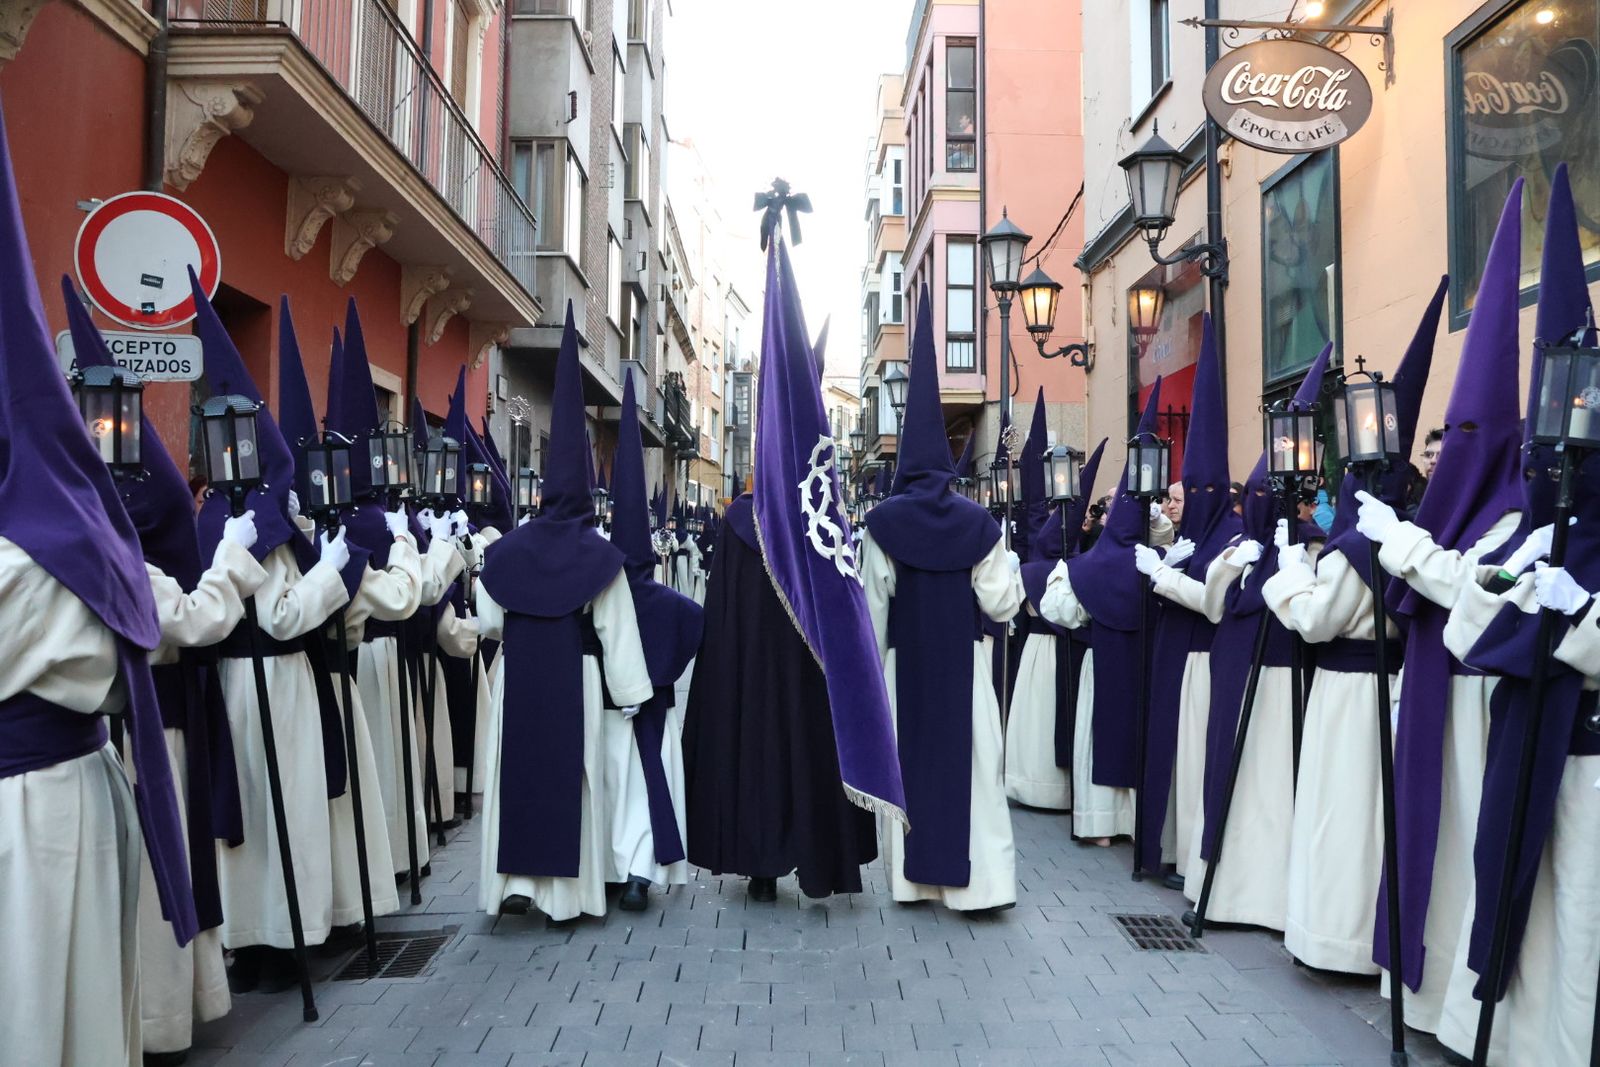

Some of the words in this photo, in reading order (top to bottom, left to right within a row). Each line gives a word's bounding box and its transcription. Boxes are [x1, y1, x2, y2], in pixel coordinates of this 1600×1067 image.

[1221, 61, 1352, 111] Coca-Cola
[1240, 117, 1291, 142] ÉPOCA
[1294, 121, 1335, 141] CAFÉ
[105, 340, 176, 355] CEPTO
